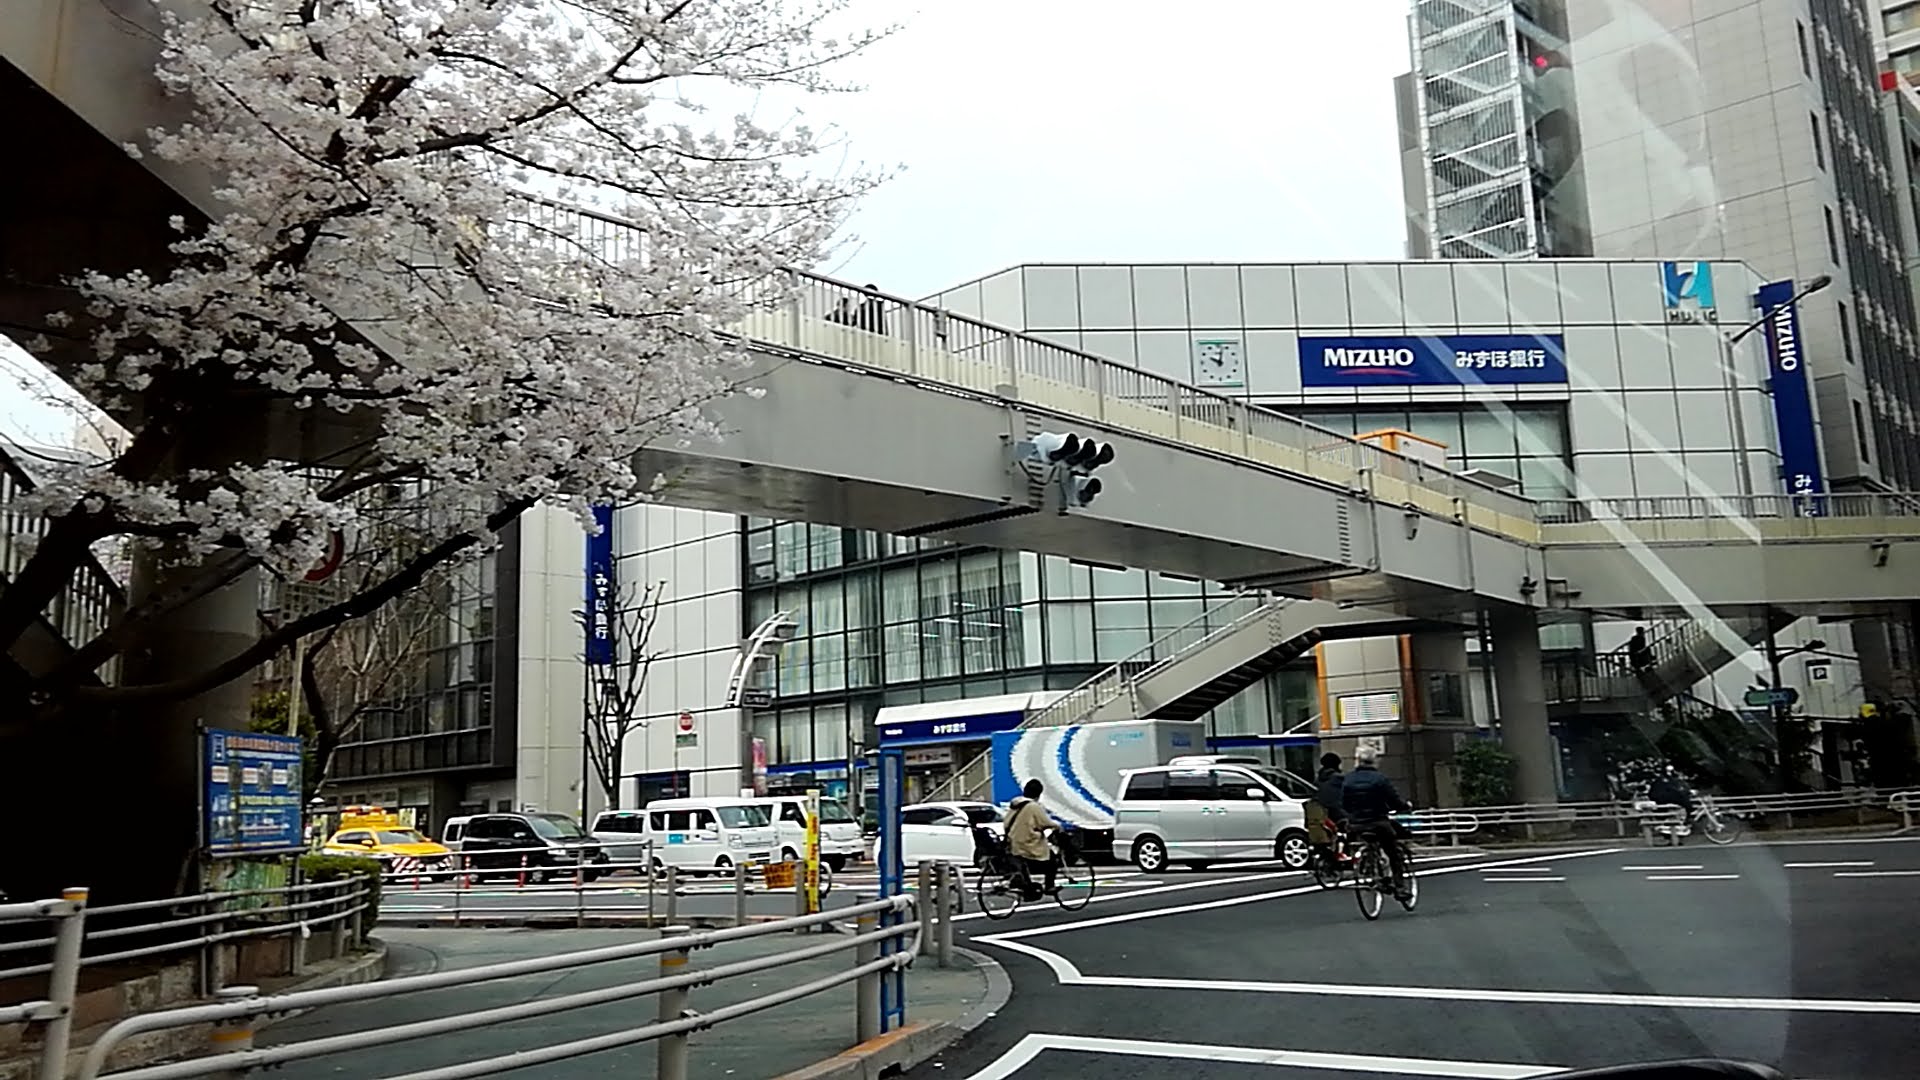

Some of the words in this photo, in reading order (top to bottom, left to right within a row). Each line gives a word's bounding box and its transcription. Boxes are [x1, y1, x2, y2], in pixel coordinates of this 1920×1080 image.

[1324, 348, 1414, 367] MIZUHO
[1455, 350, 1545, 368] みずほ銀行
[1774, 304, 1797, 371] MIZUHO
